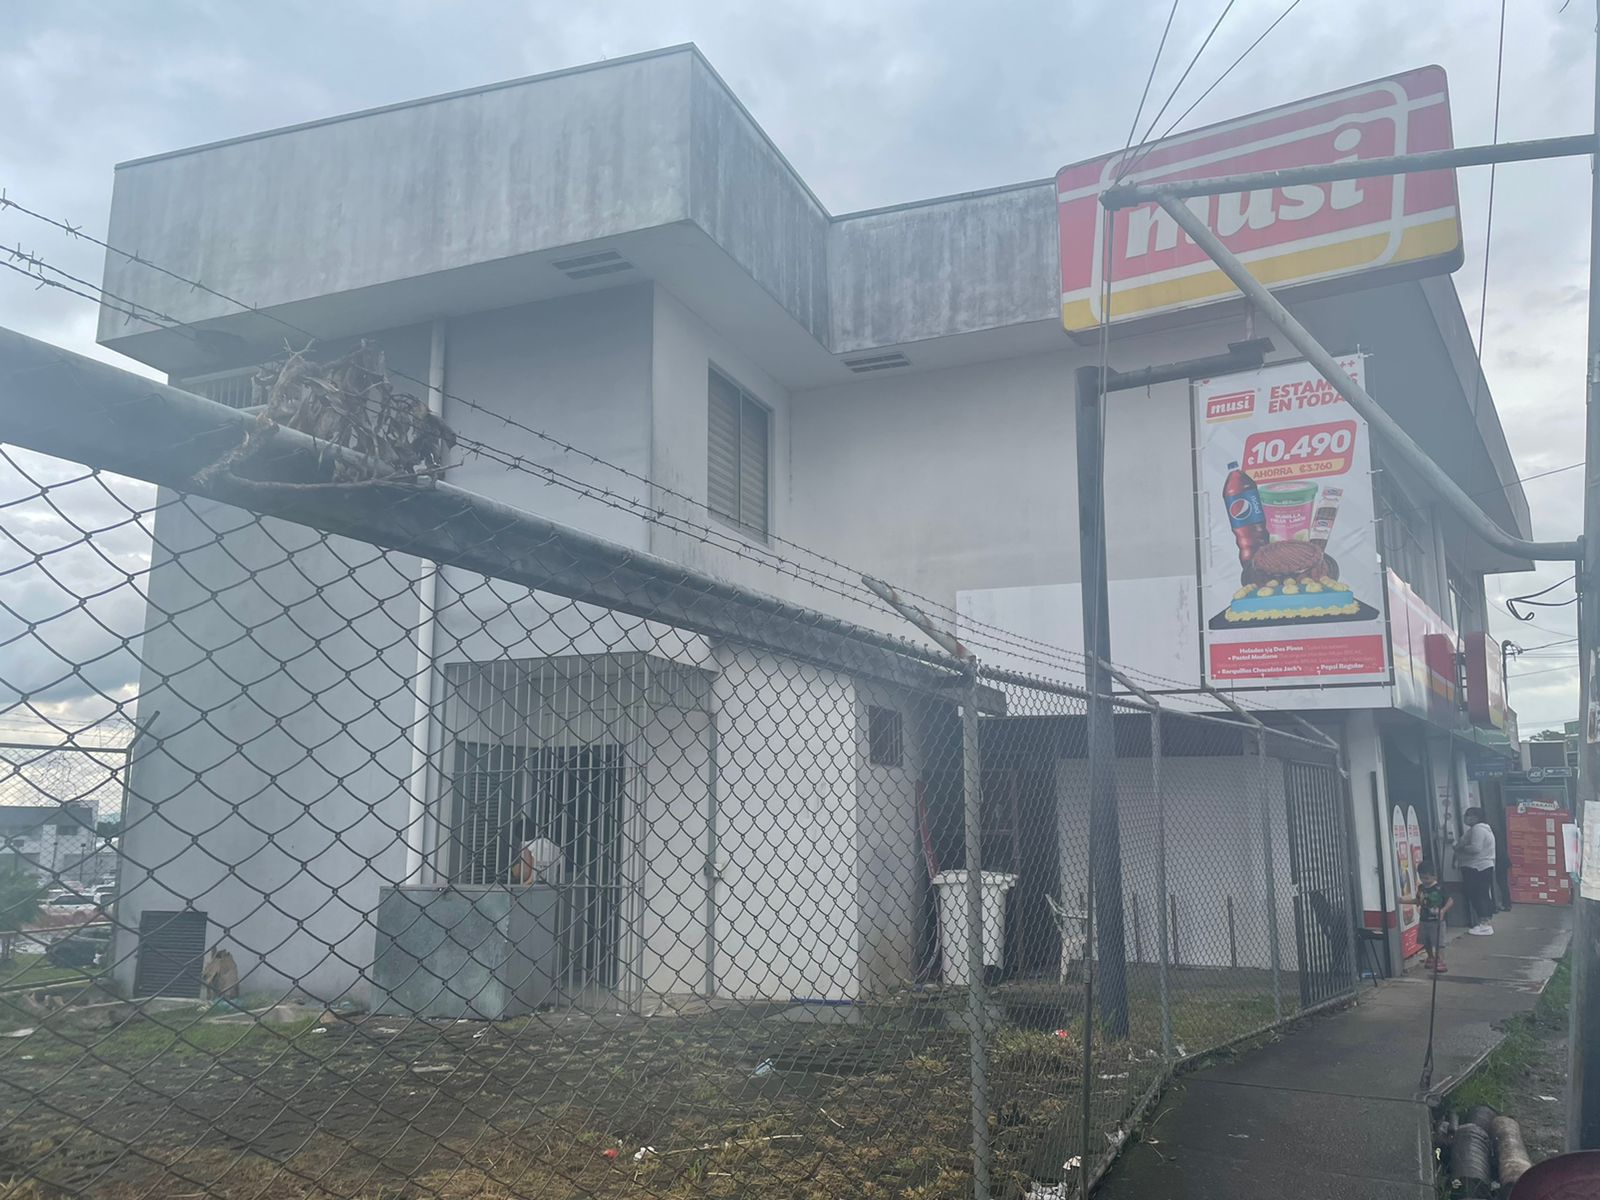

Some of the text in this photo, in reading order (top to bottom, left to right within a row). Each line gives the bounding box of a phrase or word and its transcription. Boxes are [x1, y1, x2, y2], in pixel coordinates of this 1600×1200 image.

[1125, 128, 1364, 259] musi
[1270, 372, 1358, 399] ESTAMS
[1210, 396, 1250, 415] musi
[1268, 392, 1346, 414] EN TODA
[1253, 465, 1293, 479] AHORRA
